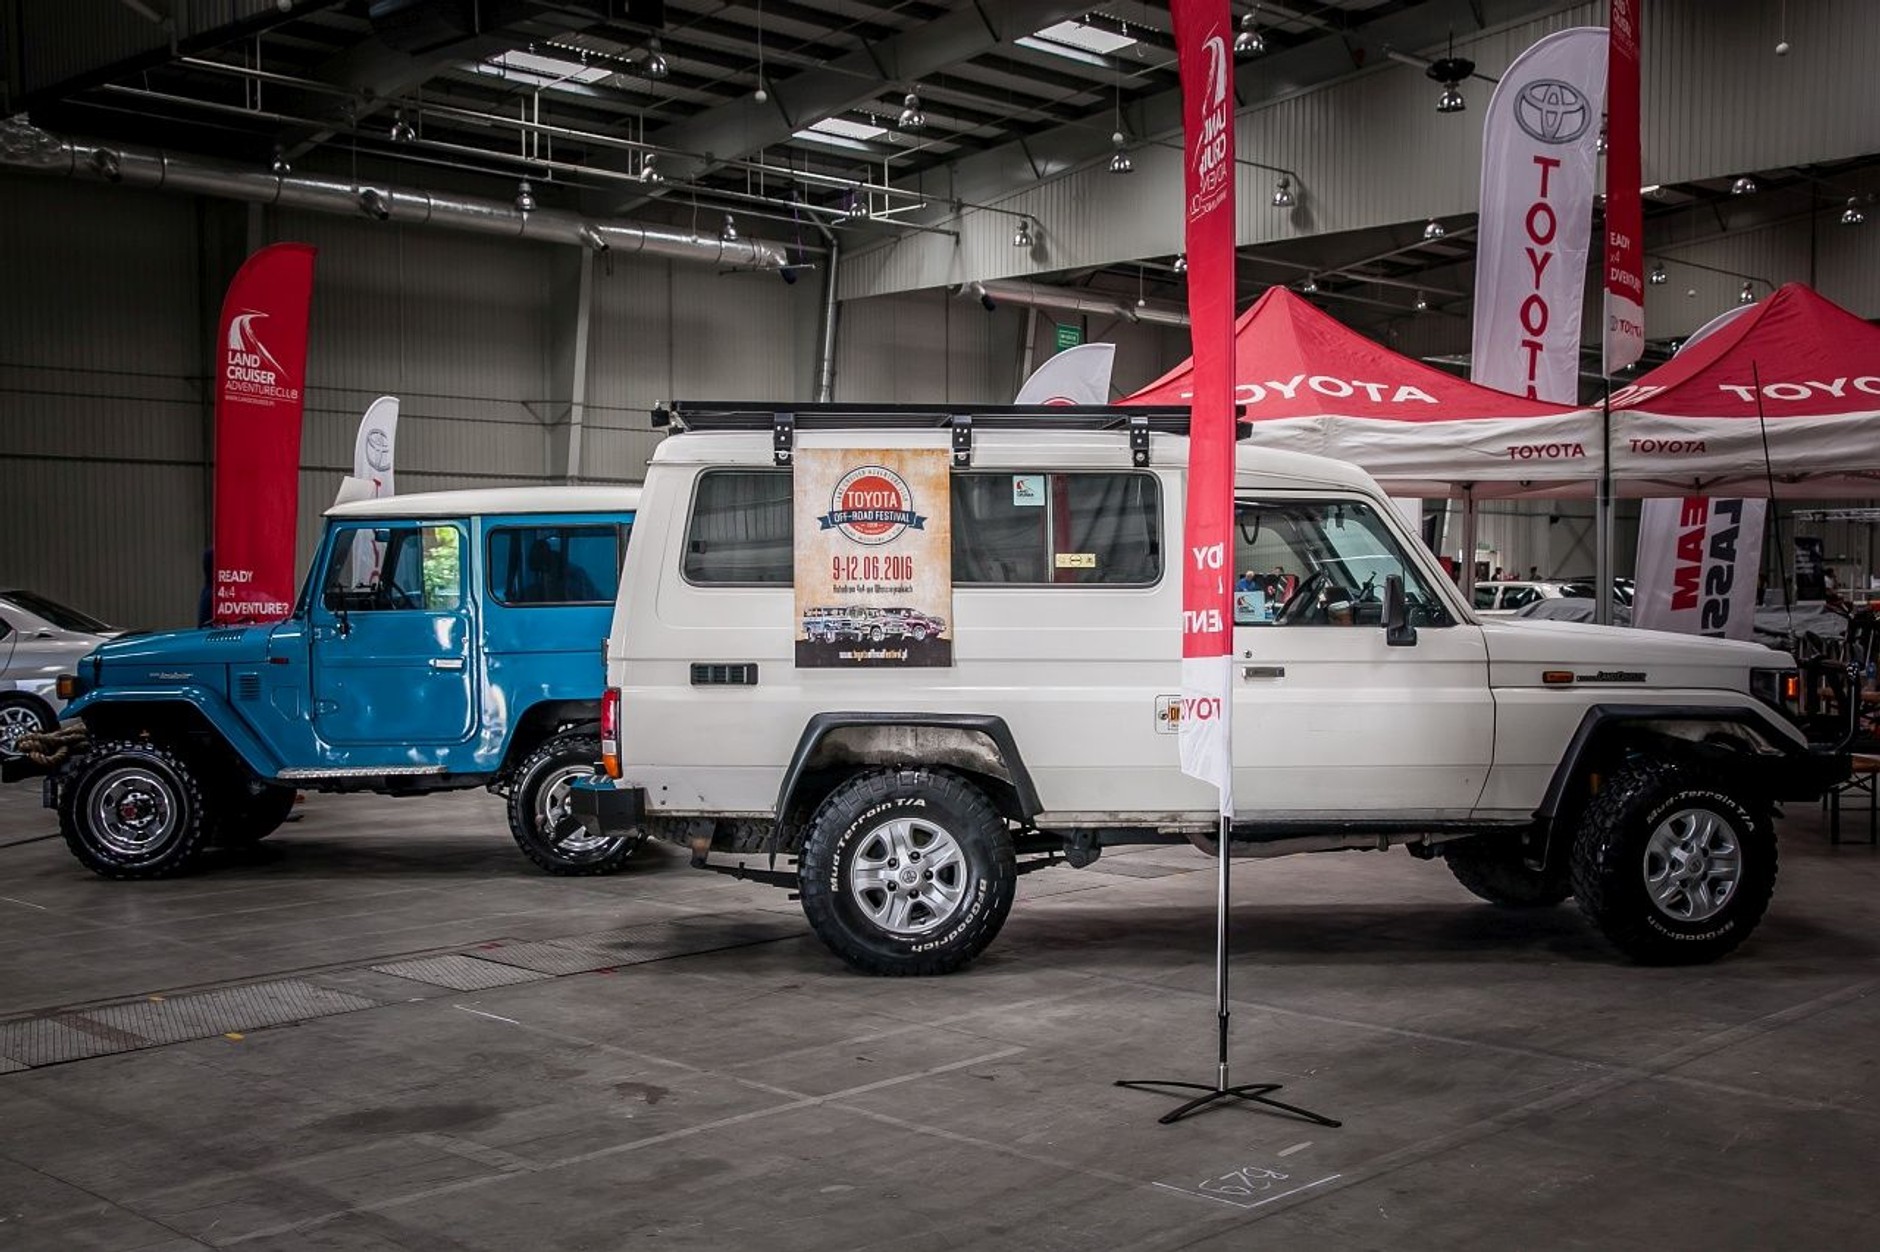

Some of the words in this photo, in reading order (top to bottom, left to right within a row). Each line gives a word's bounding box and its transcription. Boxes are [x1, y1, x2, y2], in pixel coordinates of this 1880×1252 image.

[1610, 232, 1631, 251] EADY
[228, 351, 260, 368] LAND
[227, 366, 276, 385] CRUISER
[1181, 374, 1439, 404] OYOTA
[1507, 443, 1586, 460] TOYOTA
[1629, 438, 1707, 454] TOYOTA
[847, 490, 898, 508] TOYOTA
[834, 510, 874, 523] OFF-ROAD
[875, 511, 910, 523] FESTIVAL
[218, 569, 253, 583] READY
[832, 556, 912, 581] 9-12.06.2016
[217, 602, 289, 615] ADVENTURE?
[831, 802, 892, 892] Mud-Terrain
[894, 798, 926, 808] T/A
